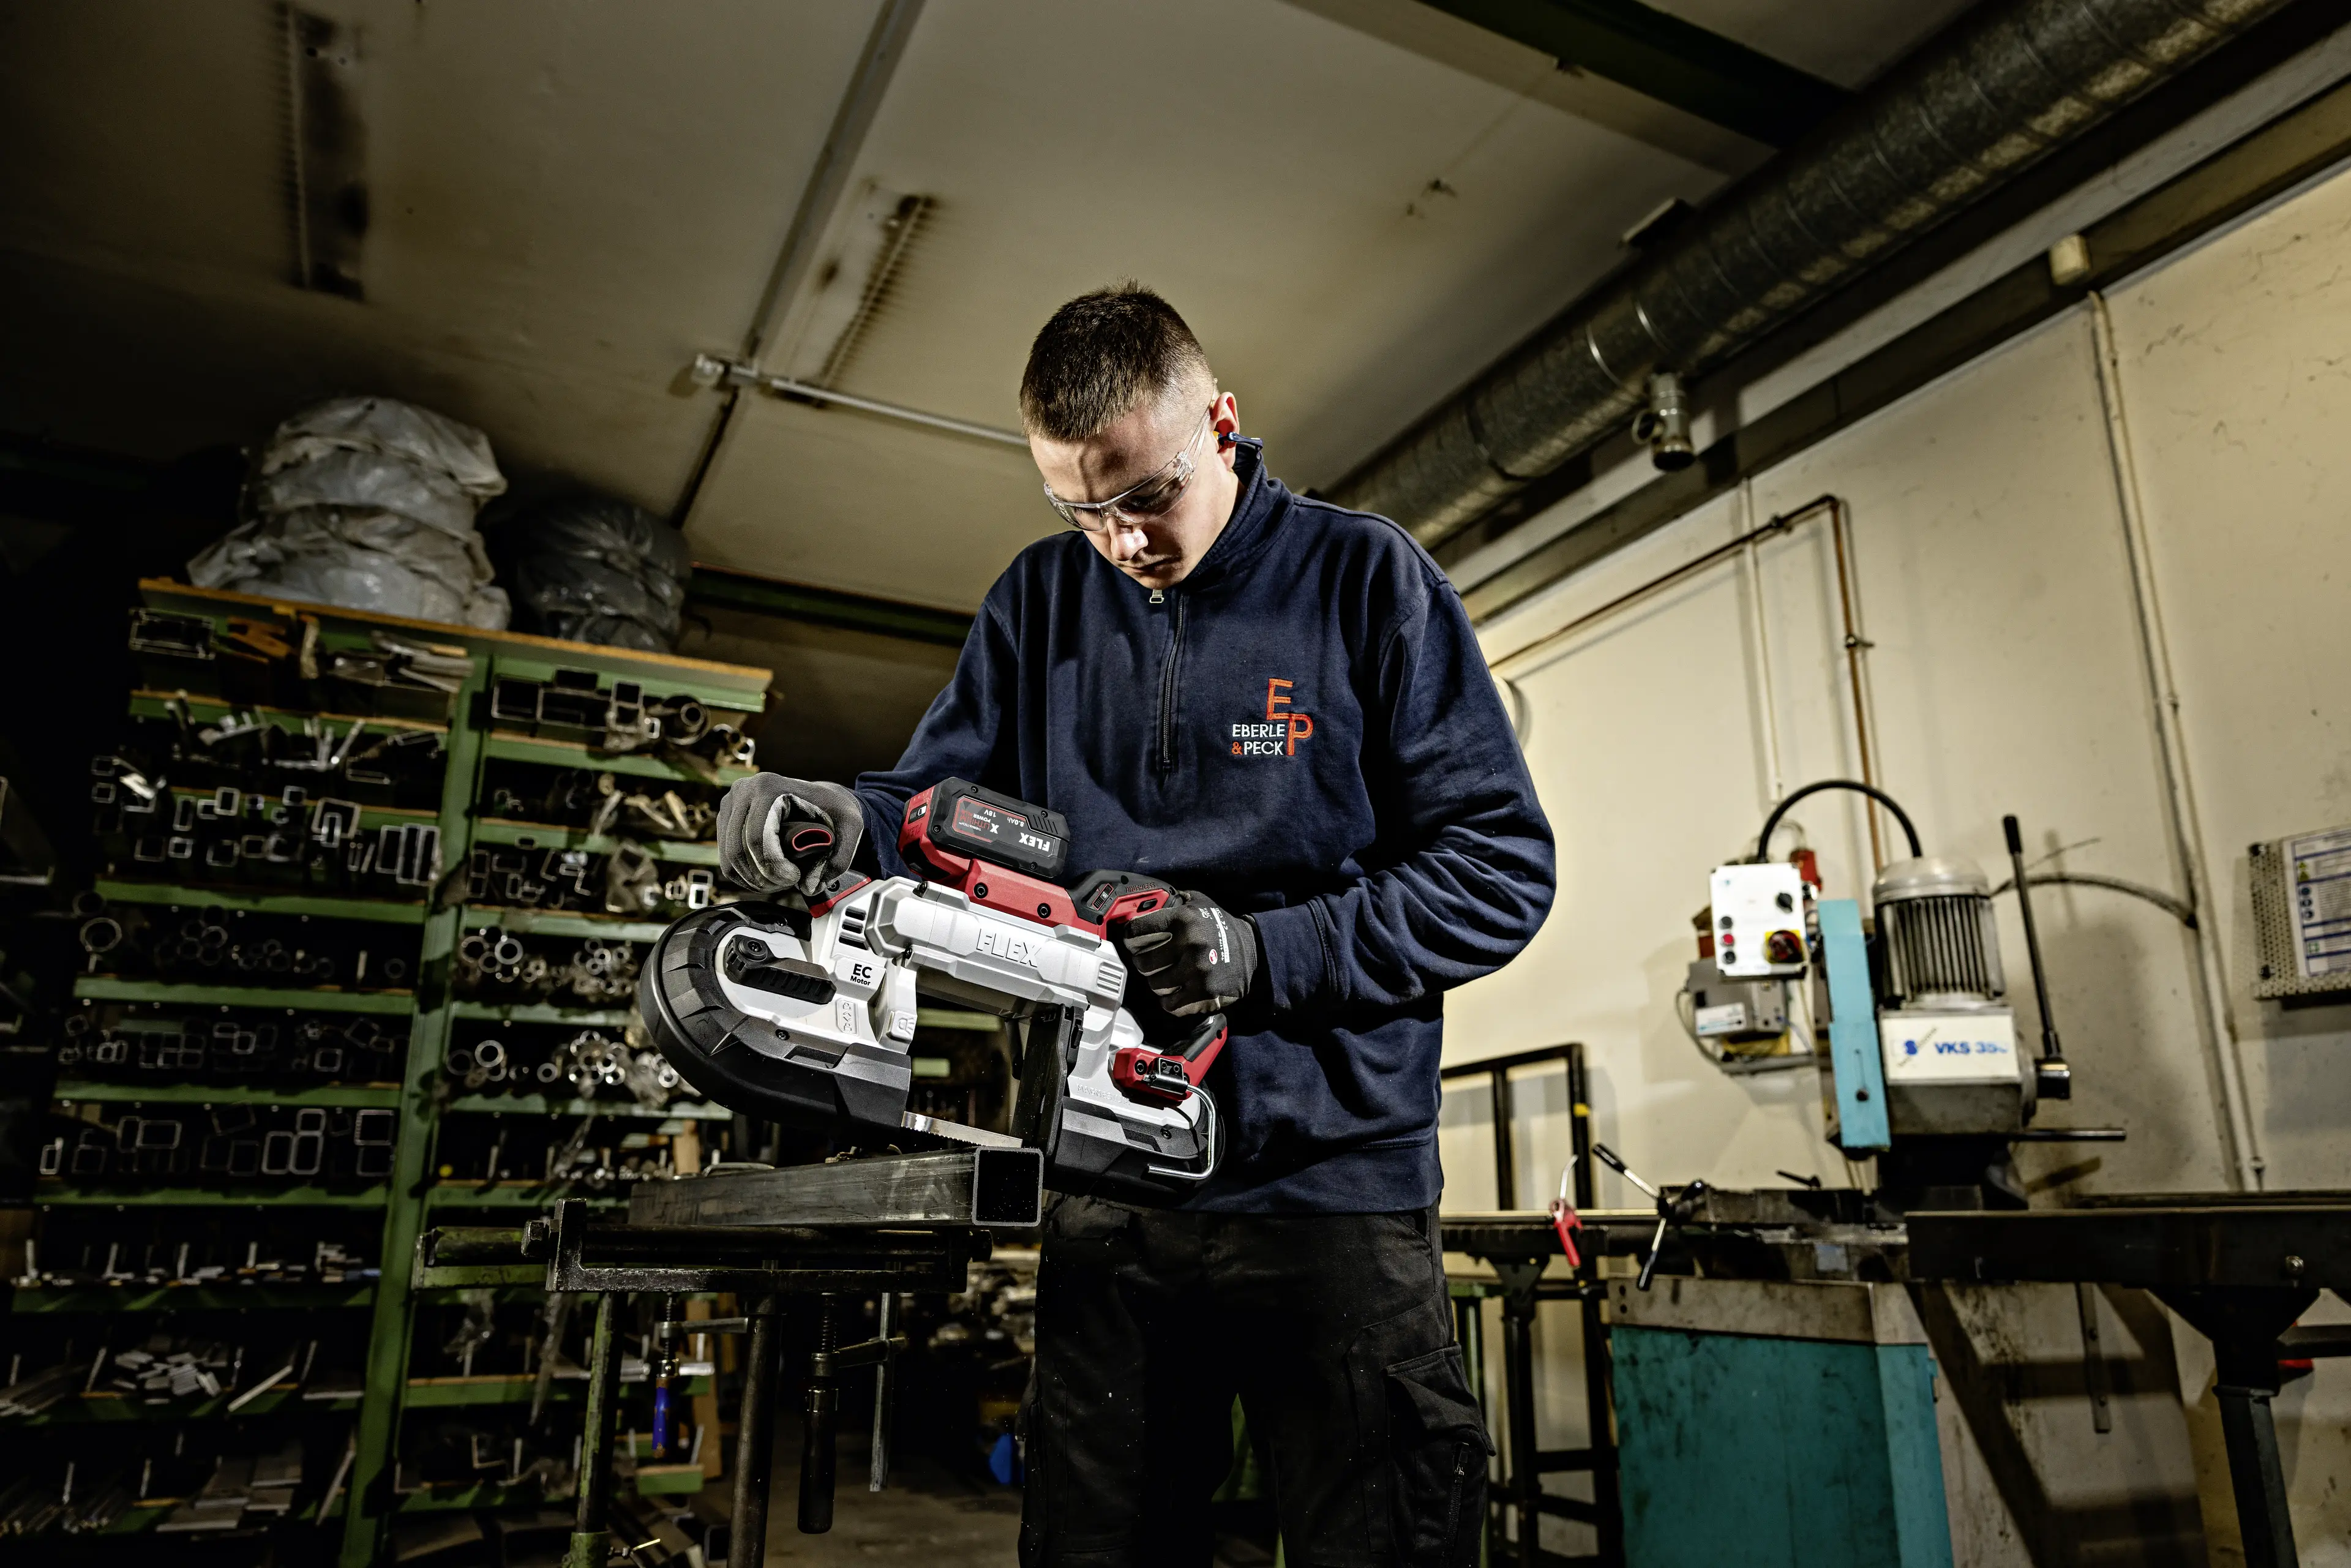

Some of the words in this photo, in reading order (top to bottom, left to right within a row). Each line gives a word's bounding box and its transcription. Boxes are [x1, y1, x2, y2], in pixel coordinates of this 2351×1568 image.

[1232, 724, 1285, 738] EBERLE
[973, 813, 991, 823] POWER
[984, 809, 997, 818] 18V
[1007, 816, 1024, 827] 8.0Ah
[1019, 832, 1051, 852] FLEX
[1125, 882, 1156, 893] BRUSHLESS
[976, 927, 1041, 968] FLEX
[852, 963, 872, 978] EC
[850, 975, 871, 986] Motor
[1935, 1041, 1971, 1054] VKS
[1076, 1083, 1131, 1105] MAGNESIUM
